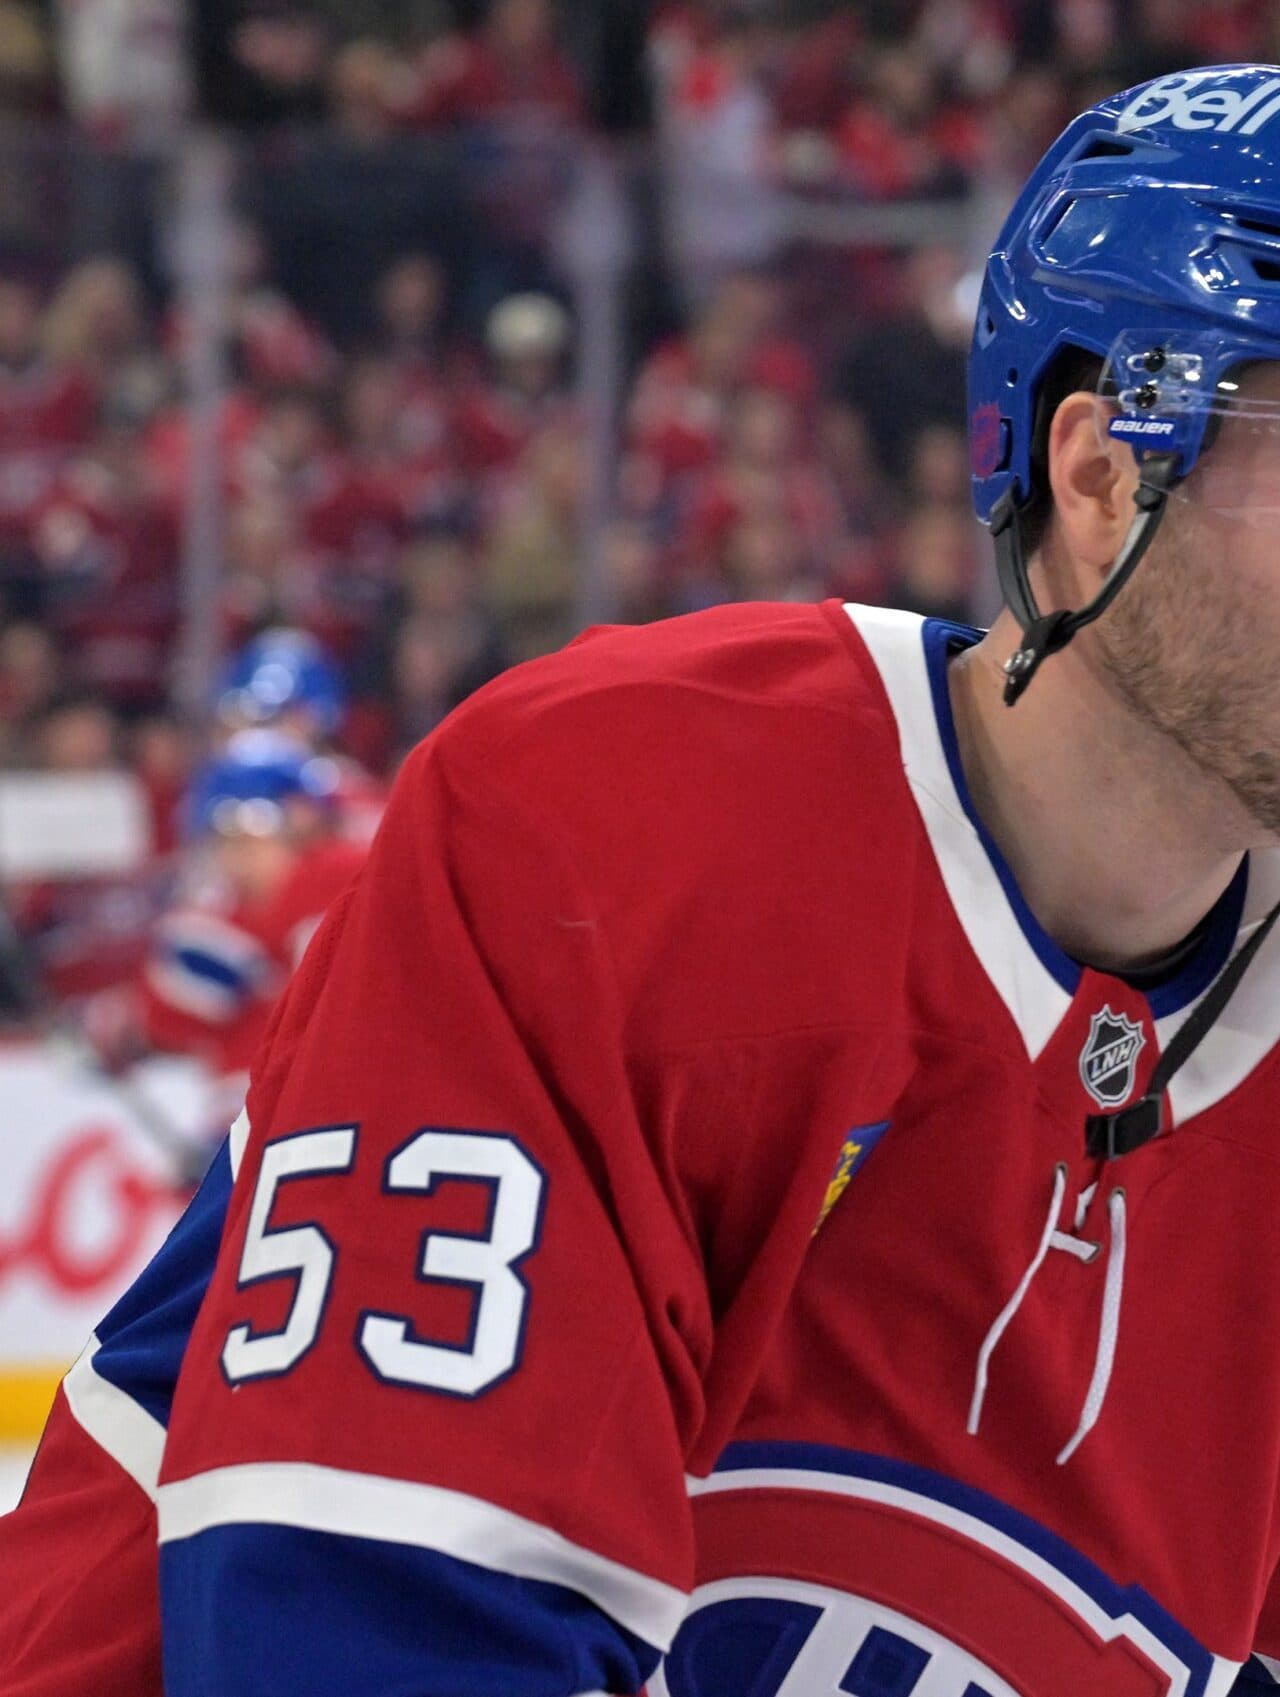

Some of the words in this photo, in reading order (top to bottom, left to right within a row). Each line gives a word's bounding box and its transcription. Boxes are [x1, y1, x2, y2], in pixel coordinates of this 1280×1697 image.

[1110, 419, 1175, 435] BAUER
[1090, 1038, 1136, 1080] LNH
[220, 1122, 548, 1400] 53
